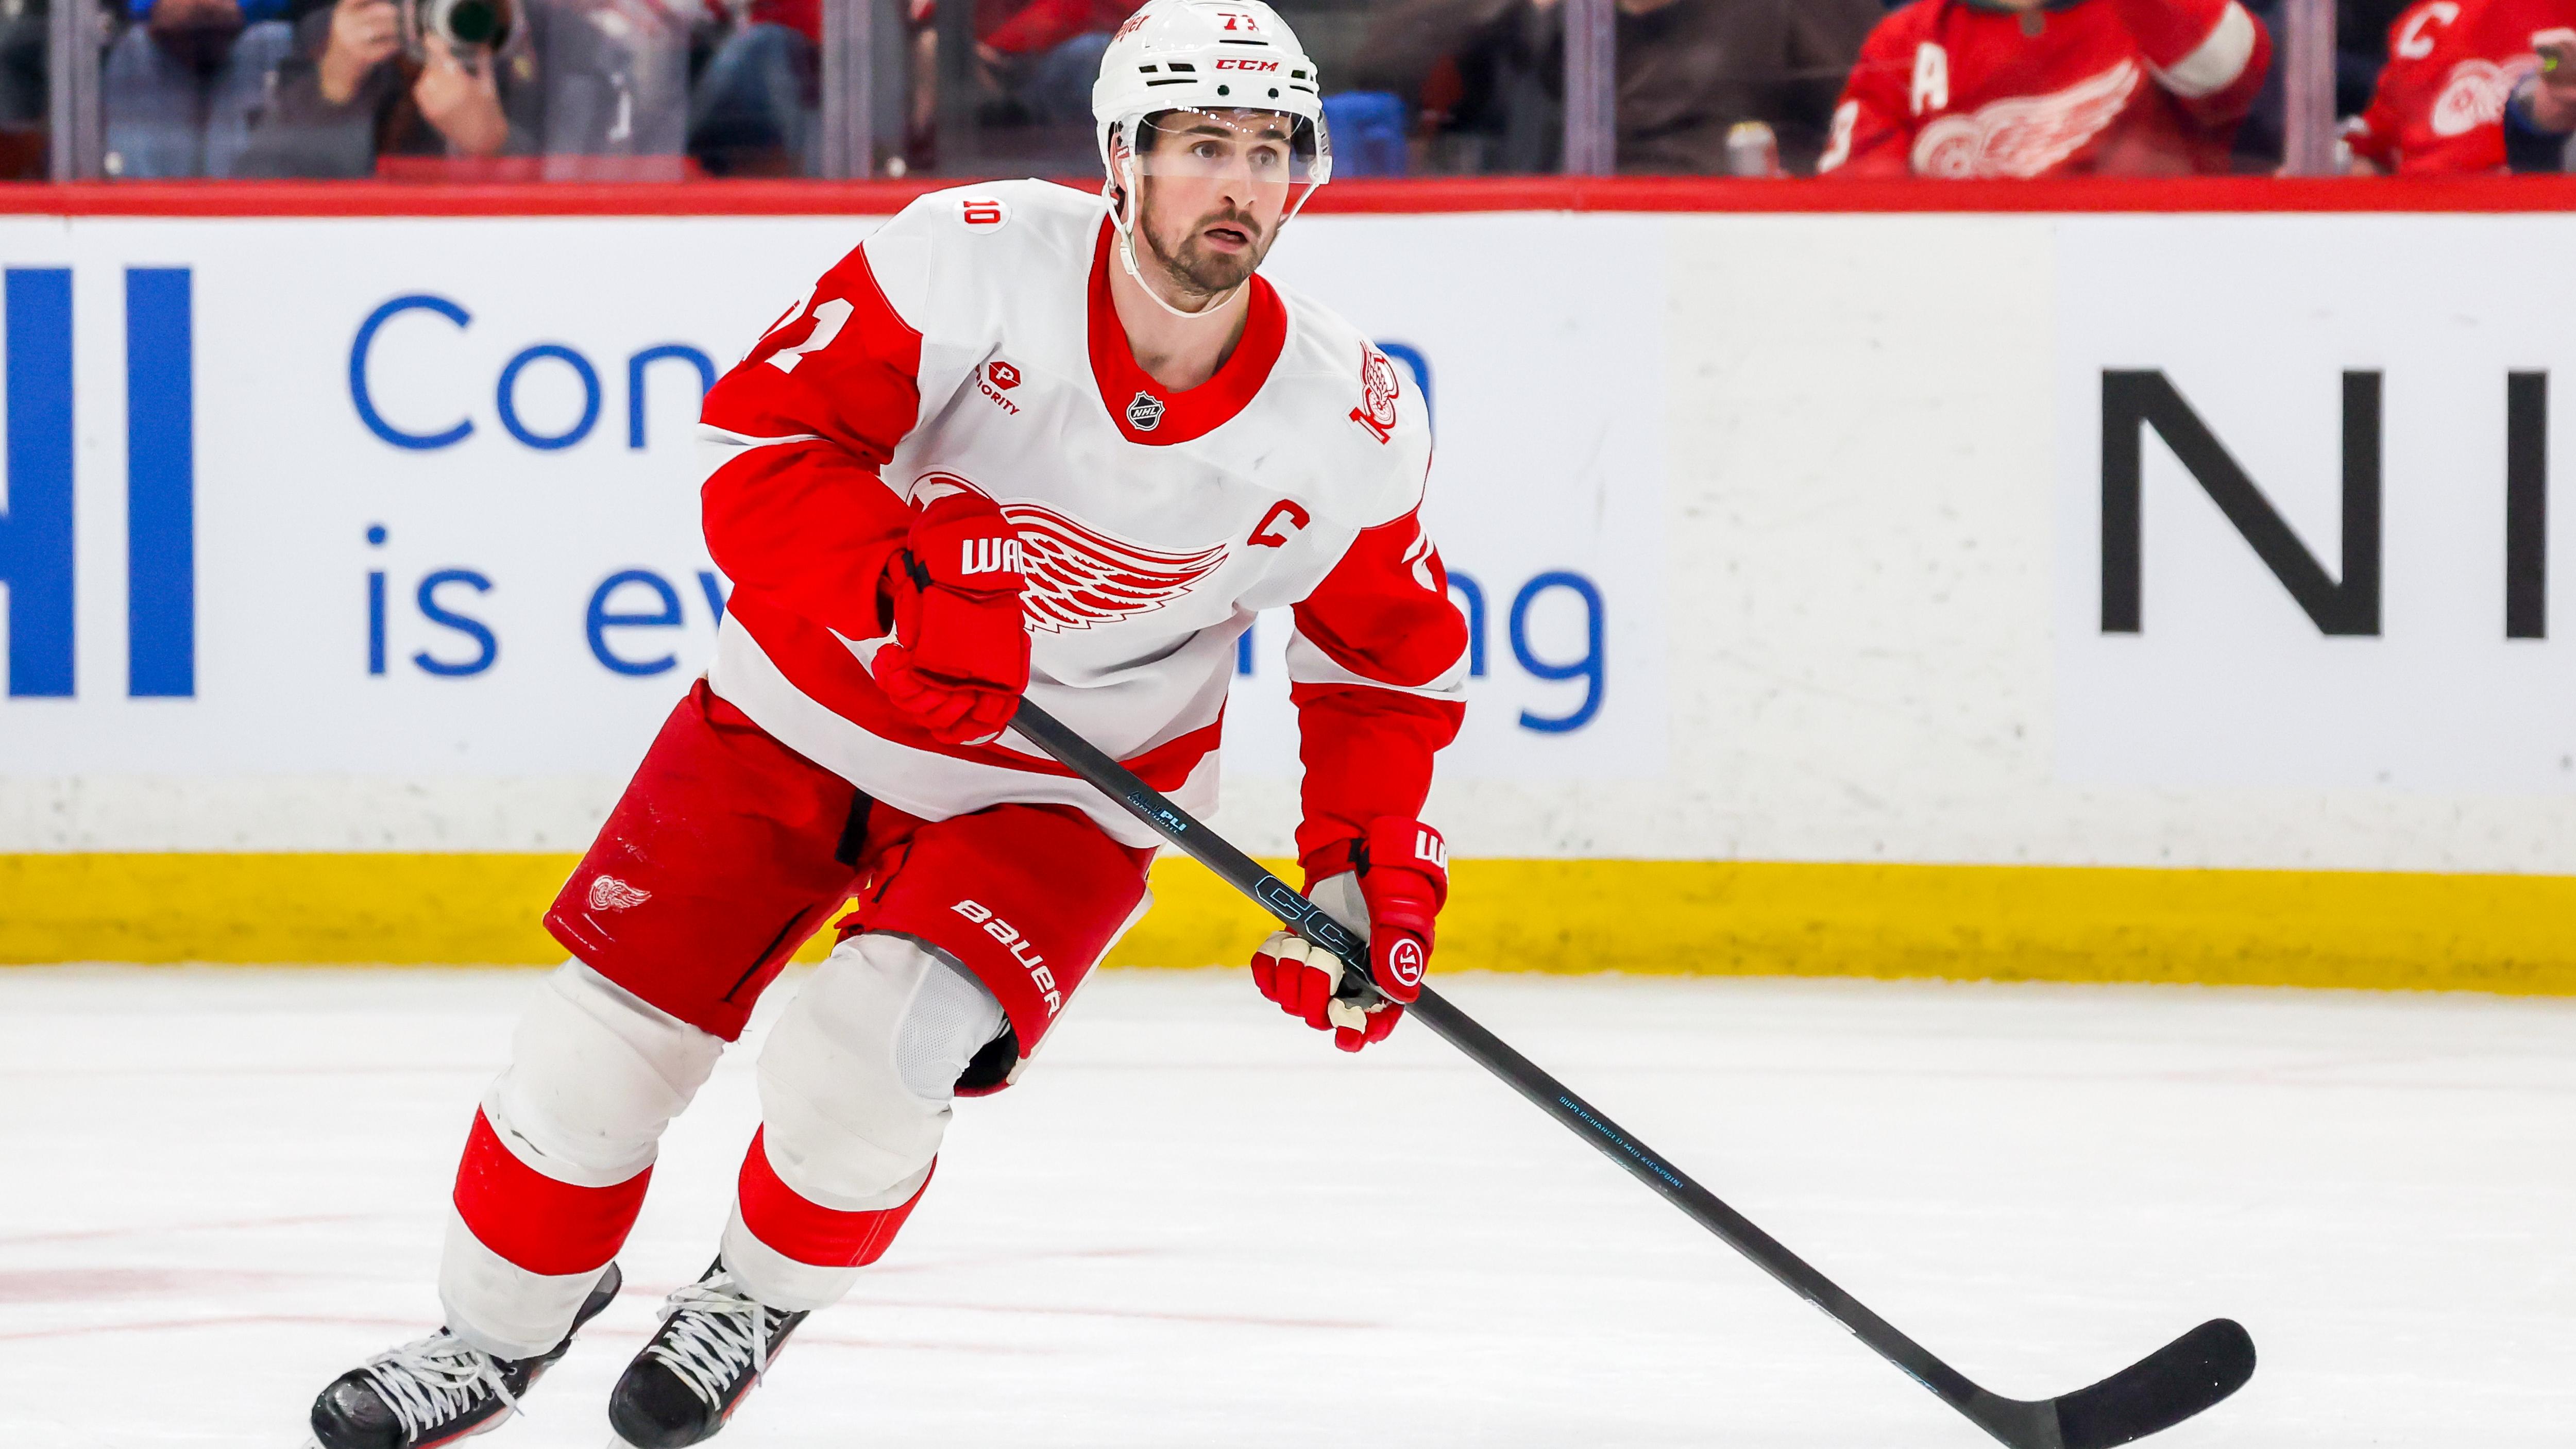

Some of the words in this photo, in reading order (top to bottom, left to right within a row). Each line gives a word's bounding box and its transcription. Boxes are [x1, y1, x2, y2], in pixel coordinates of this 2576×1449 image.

[1216, 59, 1279, 72] CCM
[1910, 40, 1948, 116] A
[963, 200, 1001, 224] 10
[1133, 407, 1157, 417] NHL
[1247, 499, 1310, 548] C
[366, 524, 498, 677] is
[1623, 1143, 1641, 1158] MID
